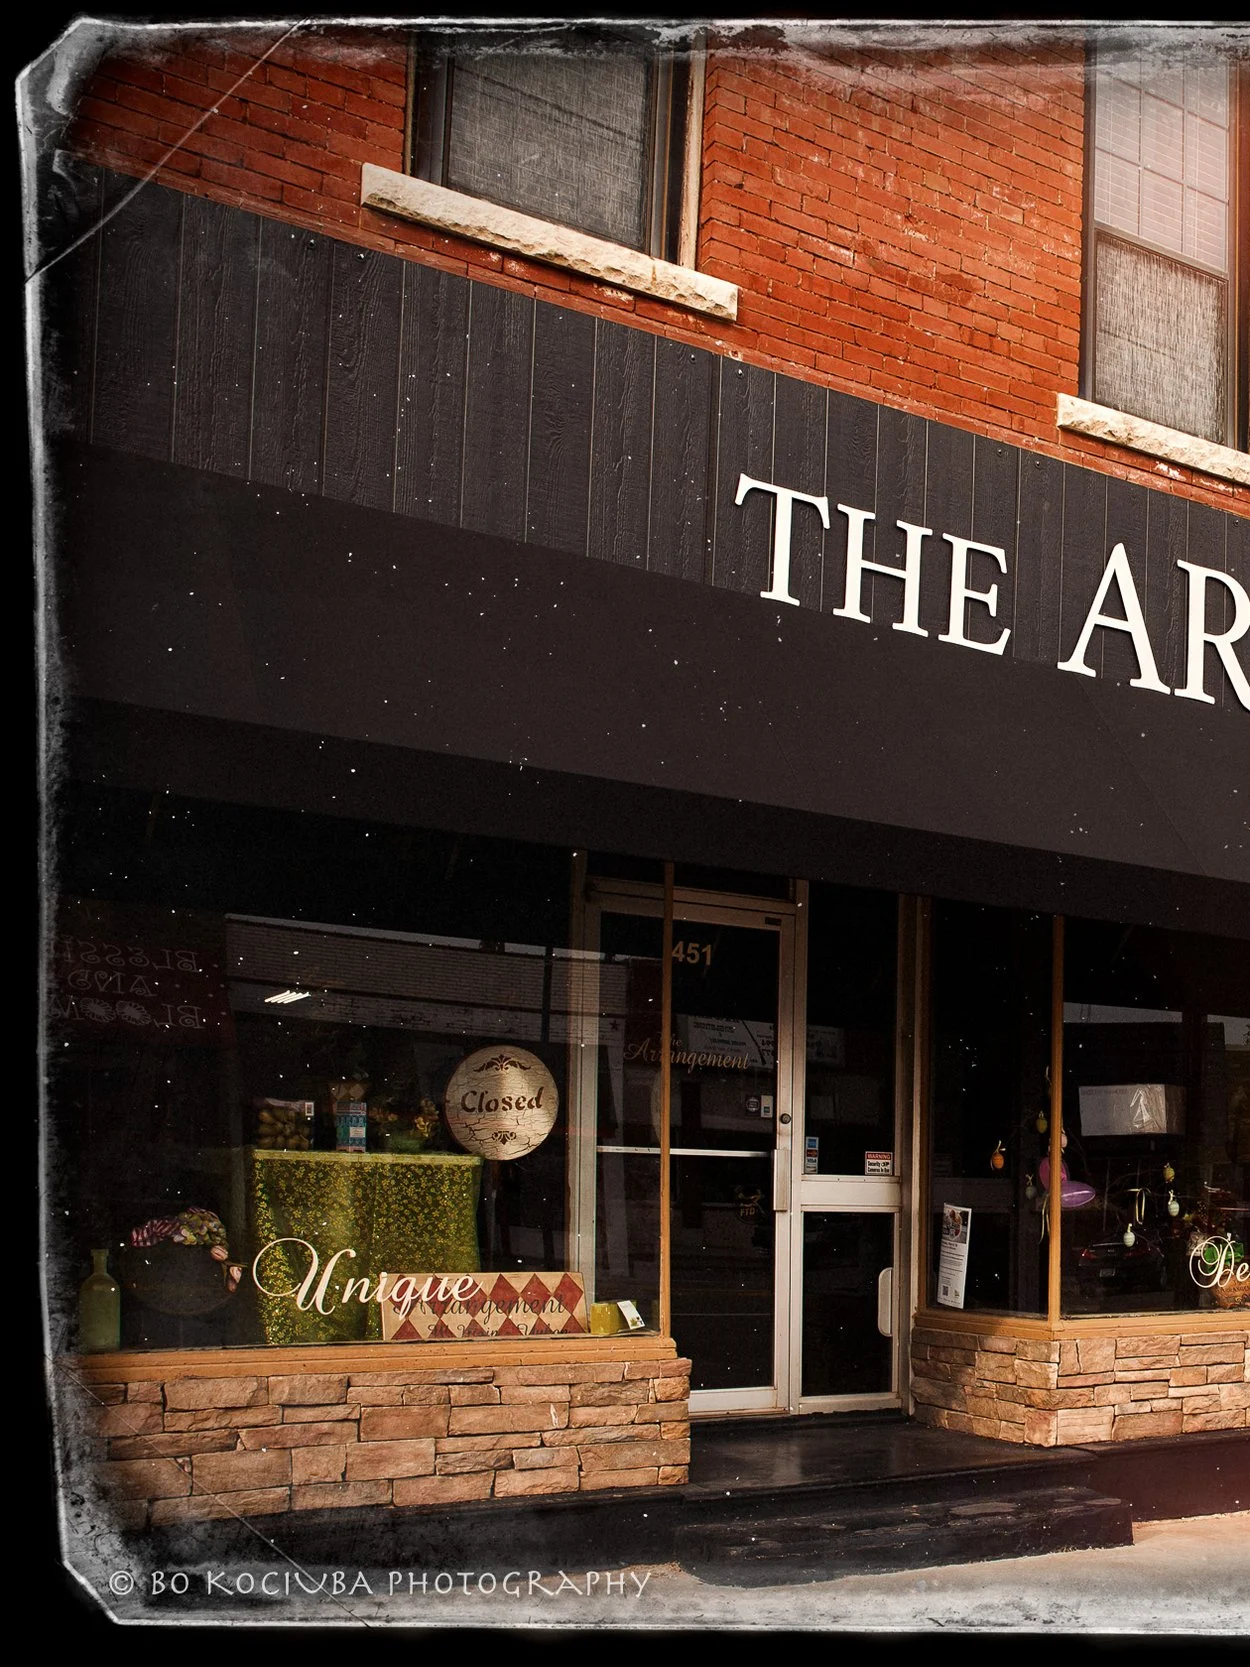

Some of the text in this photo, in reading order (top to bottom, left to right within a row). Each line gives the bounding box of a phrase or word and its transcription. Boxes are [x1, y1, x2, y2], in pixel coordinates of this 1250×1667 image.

[734, 473, 1011, 655] THE
[671, 940, 712, 966] 451
[460, 1086, 545, 1113] Closed
[252, 1237, 483, 1321] Unique
